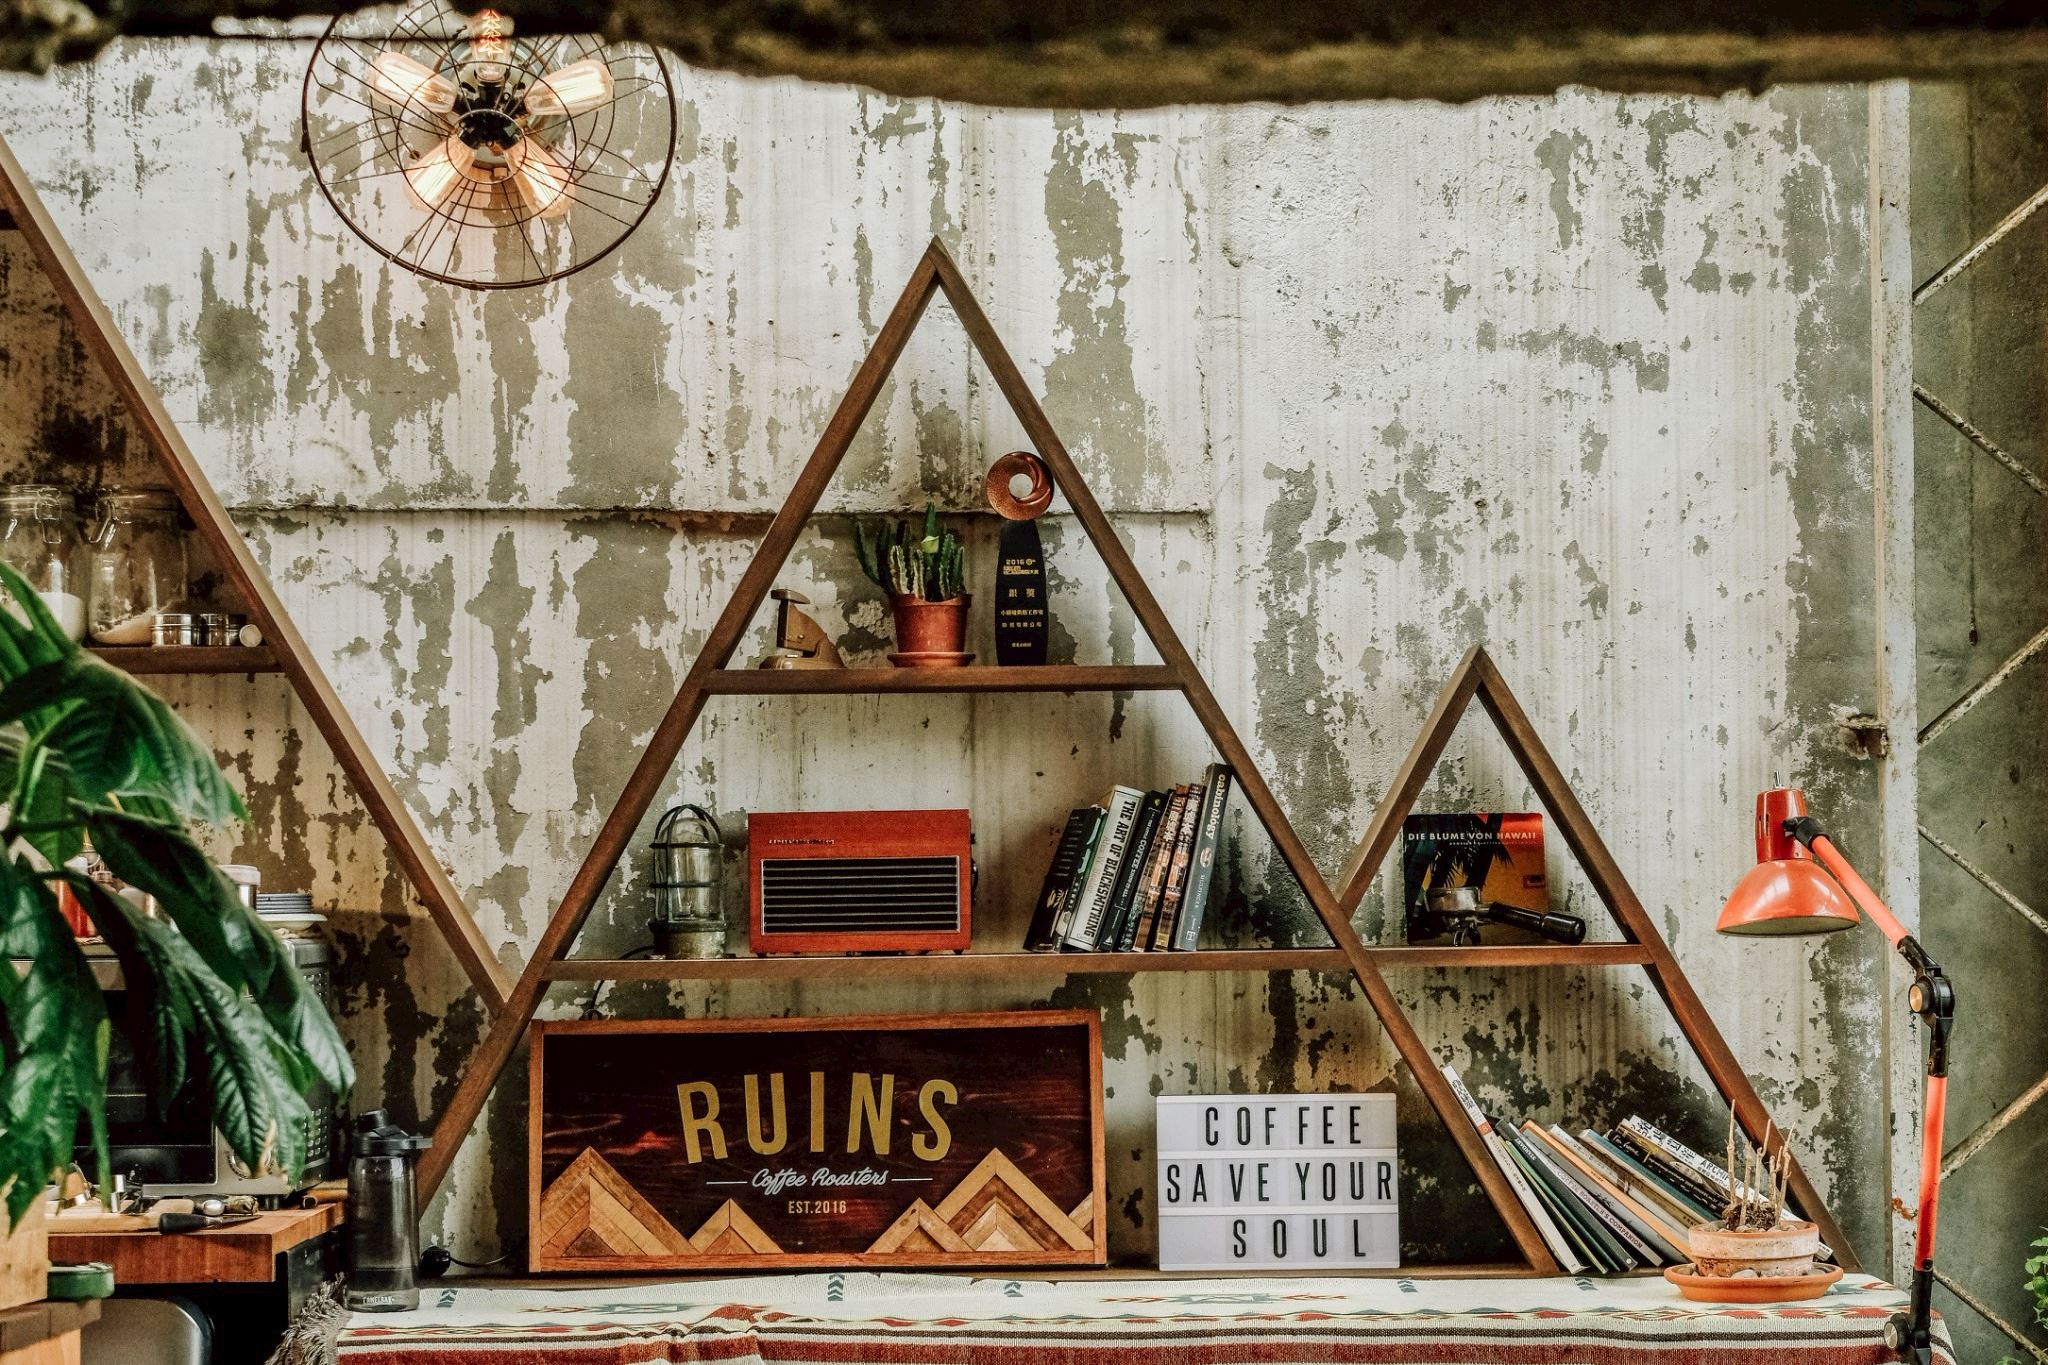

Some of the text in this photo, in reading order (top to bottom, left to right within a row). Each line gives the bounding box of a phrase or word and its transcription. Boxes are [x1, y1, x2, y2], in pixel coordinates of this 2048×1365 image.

[1119, 800, 1136, 821] THE
[1113, 821, 1130, 843] ART
[1408, 832, 1537, 841] DIE BLUME VON HAWAII
[1109, 842, 1123, 858] OF
[1130, 838, 1147, 869] COFFEE
[1083, 856, 1118, 937] BLACKSMITHING
[677, 1071, 958, 1164] RUINS
[1205, 1106, 1362, 1147] COFFEE
[751, 1166, 890, 1196] Coffee Roasters
[1166, 1161, 1393, 1203] SAVE YOUR
[788, 1200, 848, 1215] EST.2016
[1232, 1218, 1367, 1259] SOUL
[1608, 1216, 1643, 1249] COMPANION
